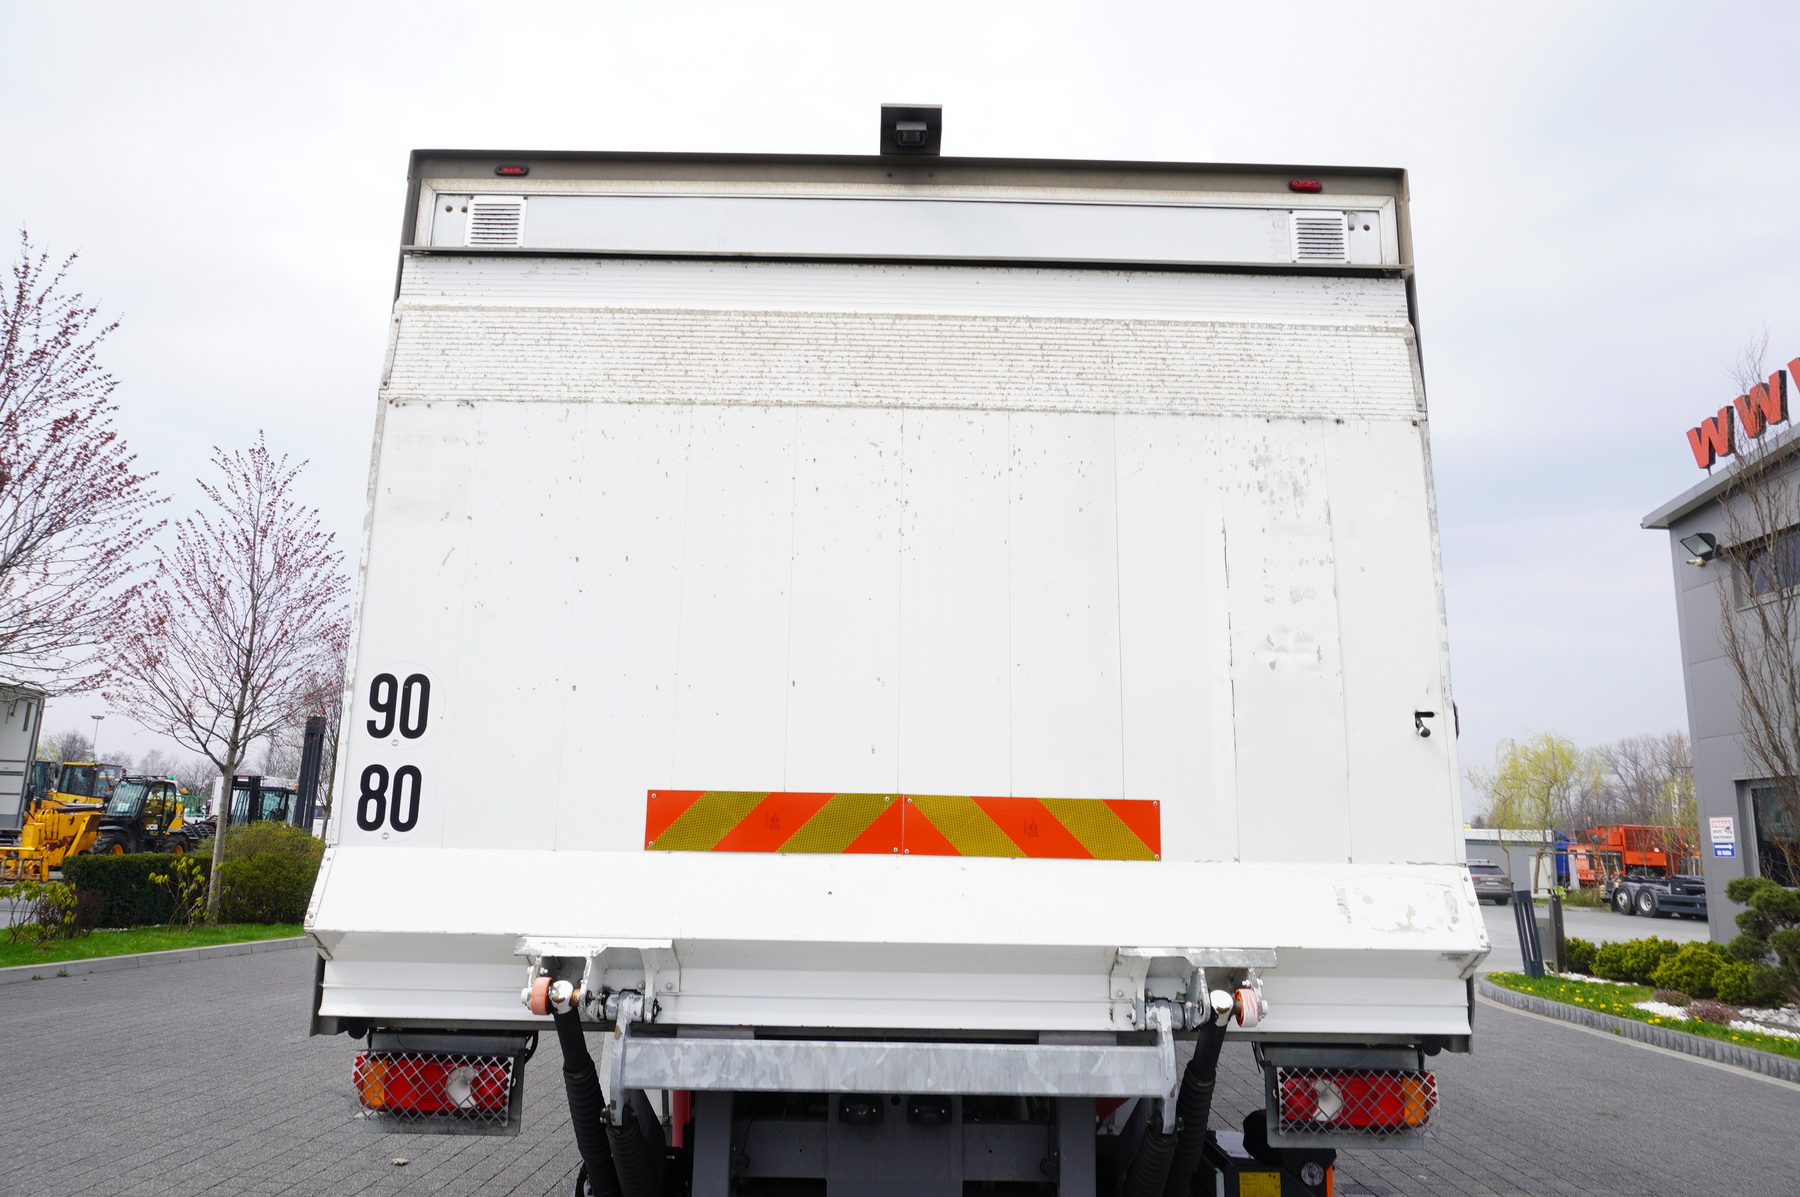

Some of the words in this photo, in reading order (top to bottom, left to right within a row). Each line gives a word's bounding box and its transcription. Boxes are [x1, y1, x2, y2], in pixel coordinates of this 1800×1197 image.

[366, 673, 431, 739] 90
[145, 823, 159, 831] JCB
[356, 763, 422, 832] 80
